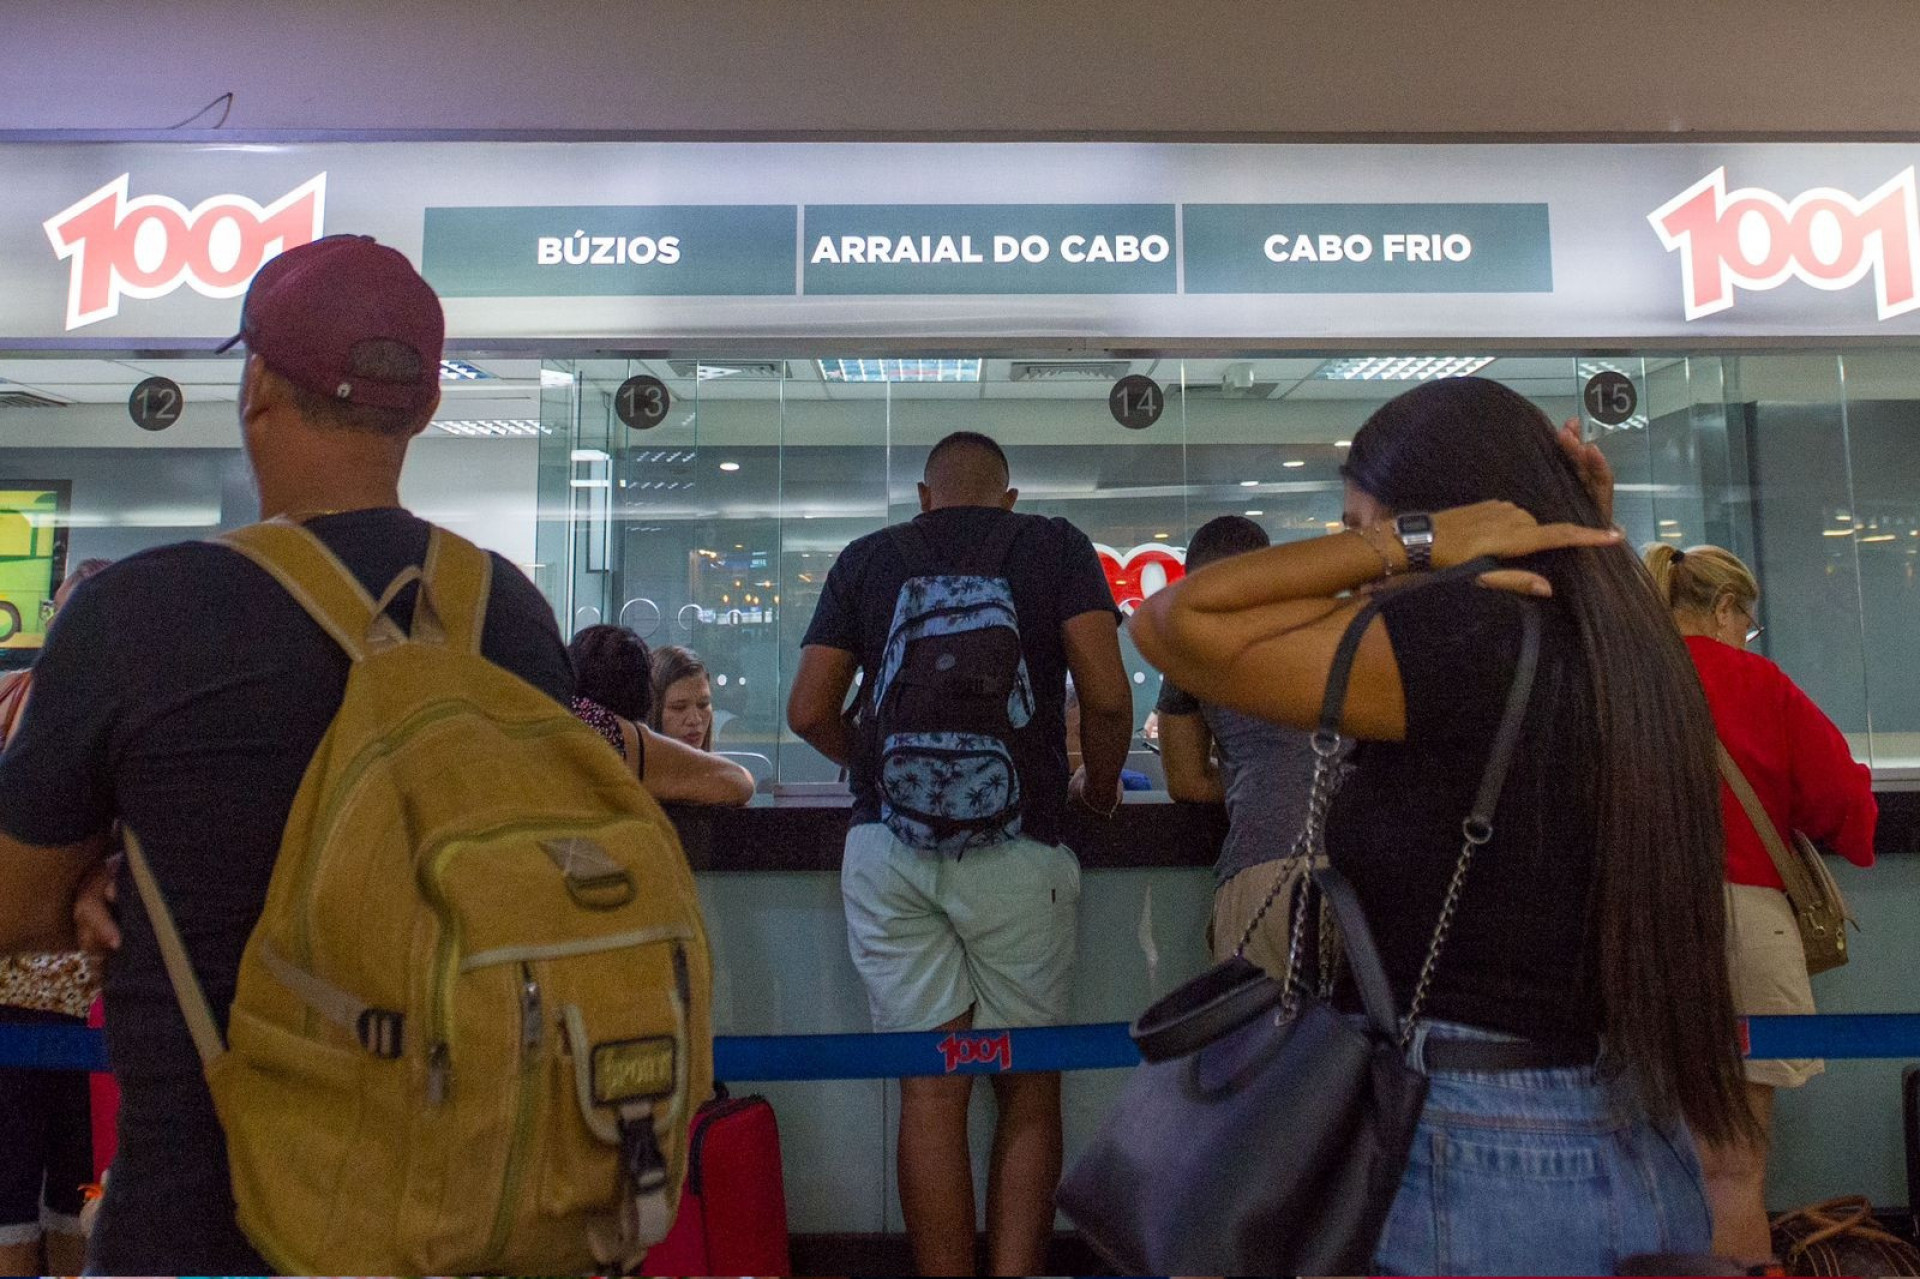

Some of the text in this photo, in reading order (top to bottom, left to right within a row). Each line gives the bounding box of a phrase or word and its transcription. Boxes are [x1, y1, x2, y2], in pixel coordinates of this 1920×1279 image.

[537, 229, 680, 265] BÚZIOS
[810, 234, 1170, 263] ARRAIAL DO CABO
[1263, 233, 1471, 262] CABO FRIO
[1646, 165, 1920, 321] 1001
[137, 388, 176, 420] 12
[623, 386, 663, 418] 13
[1117, 386, 1157, 418] 14
[1591, 383, 1631, 414] 15
[936, 1031, 1012, 1073] 1001
